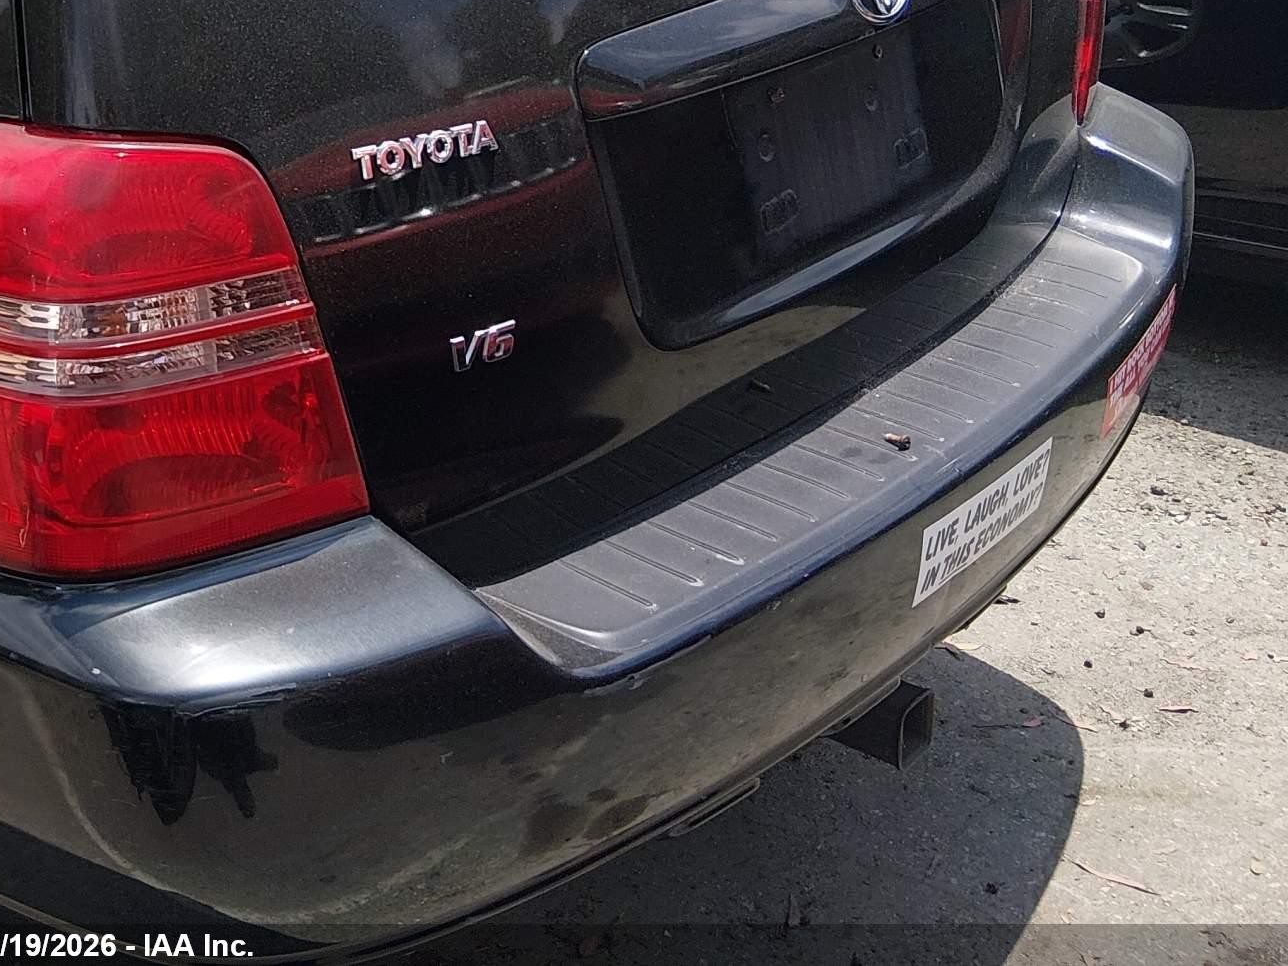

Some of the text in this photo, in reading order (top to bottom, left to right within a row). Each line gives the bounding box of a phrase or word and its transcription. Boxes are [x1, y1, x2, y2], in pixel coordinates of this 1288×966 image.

[351, 120, 500, 180] TOYOTA
[449, 319, 517, 372] V6
[919, 481, 1044, 595] IN THIS ECONOMY?
[925, 448, 1051, 562] LIVE, LAUGH, LOVE?
